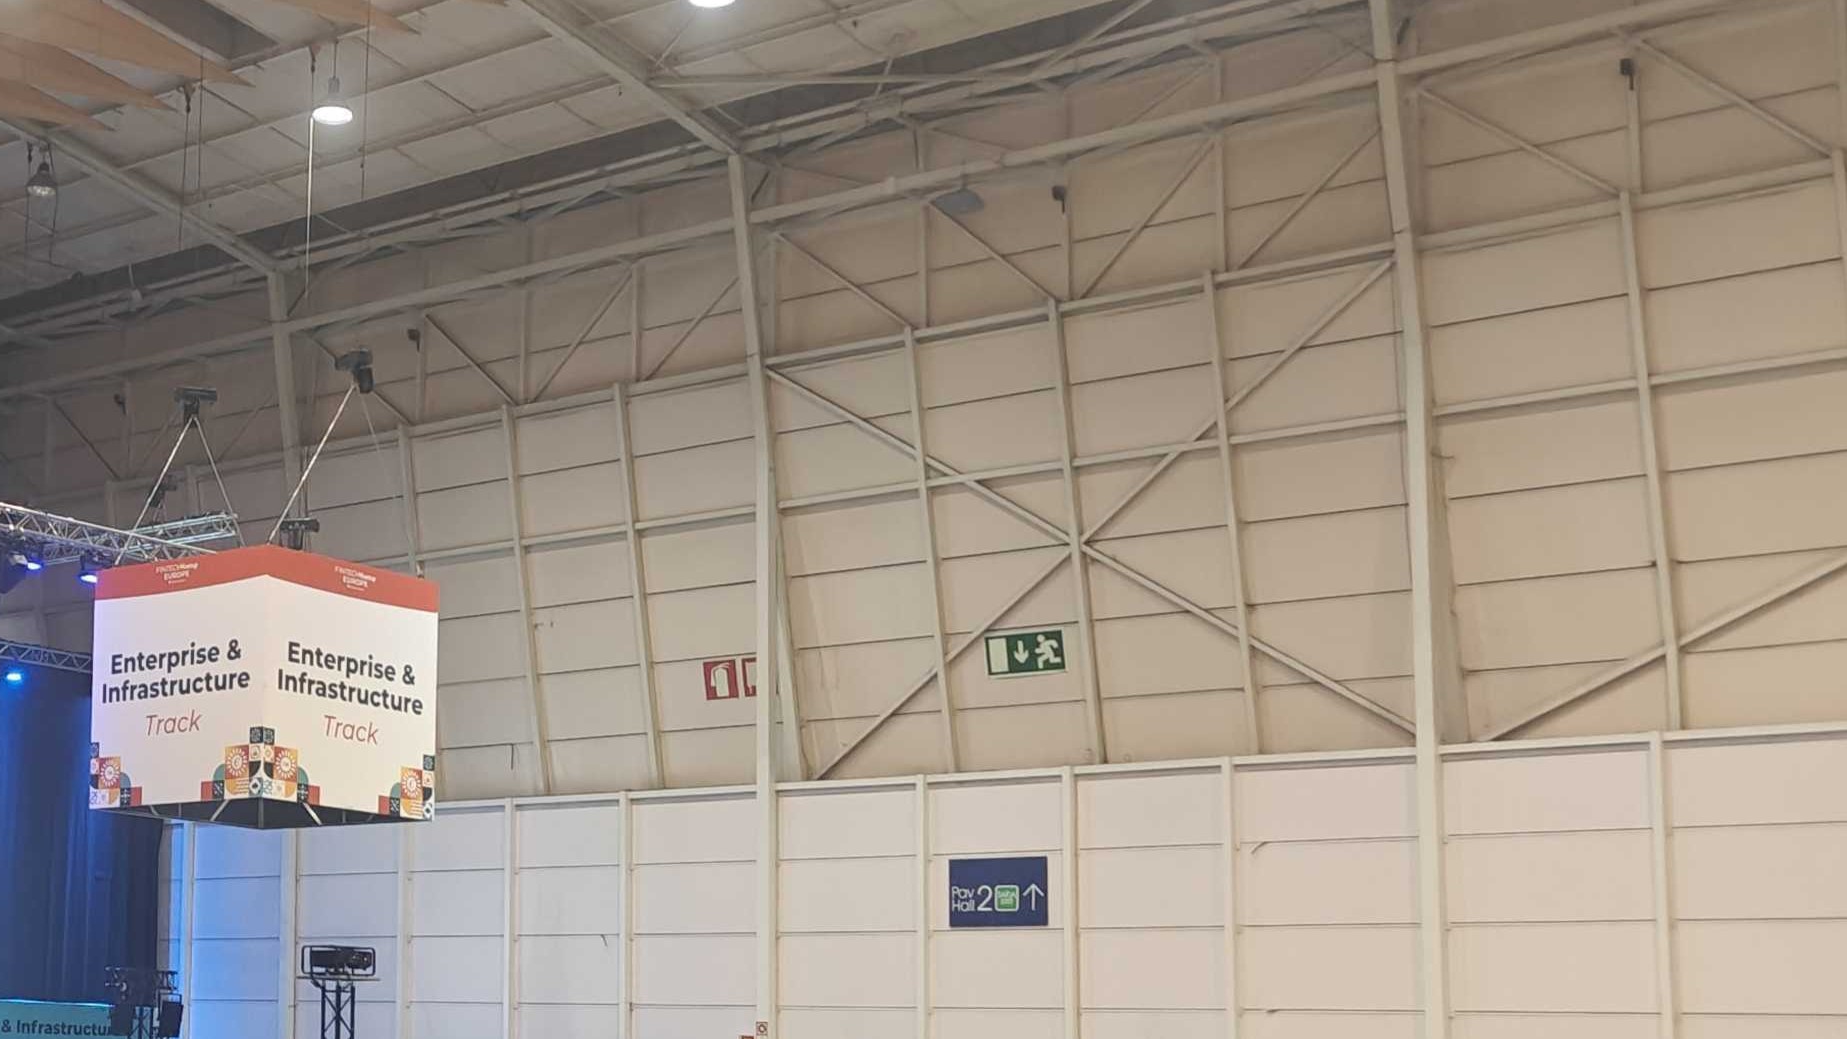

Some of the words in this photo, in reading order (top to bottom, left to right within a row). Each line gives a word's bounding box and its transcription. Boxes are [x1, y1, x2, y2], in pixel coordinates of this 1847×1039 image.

[111, 642, 220, 675] Enterprise
[228, 639, 242, 660] &
[288, 641, 396, 682] Enterprise
[402, 664, 416, 685] &
[102, 670, 250, 704] Infrastructure
[278, 669, 423, 715] Infrastructure
[145, 710, 203, 737] Track
[324, 715, 379, 746] Track
[952, 900, 975, 911] Hall
[977, 885, 992, 911] 2
[1, 1019, 12, 1033] &
[16, 1020, 110, 1037] Infrastructu
